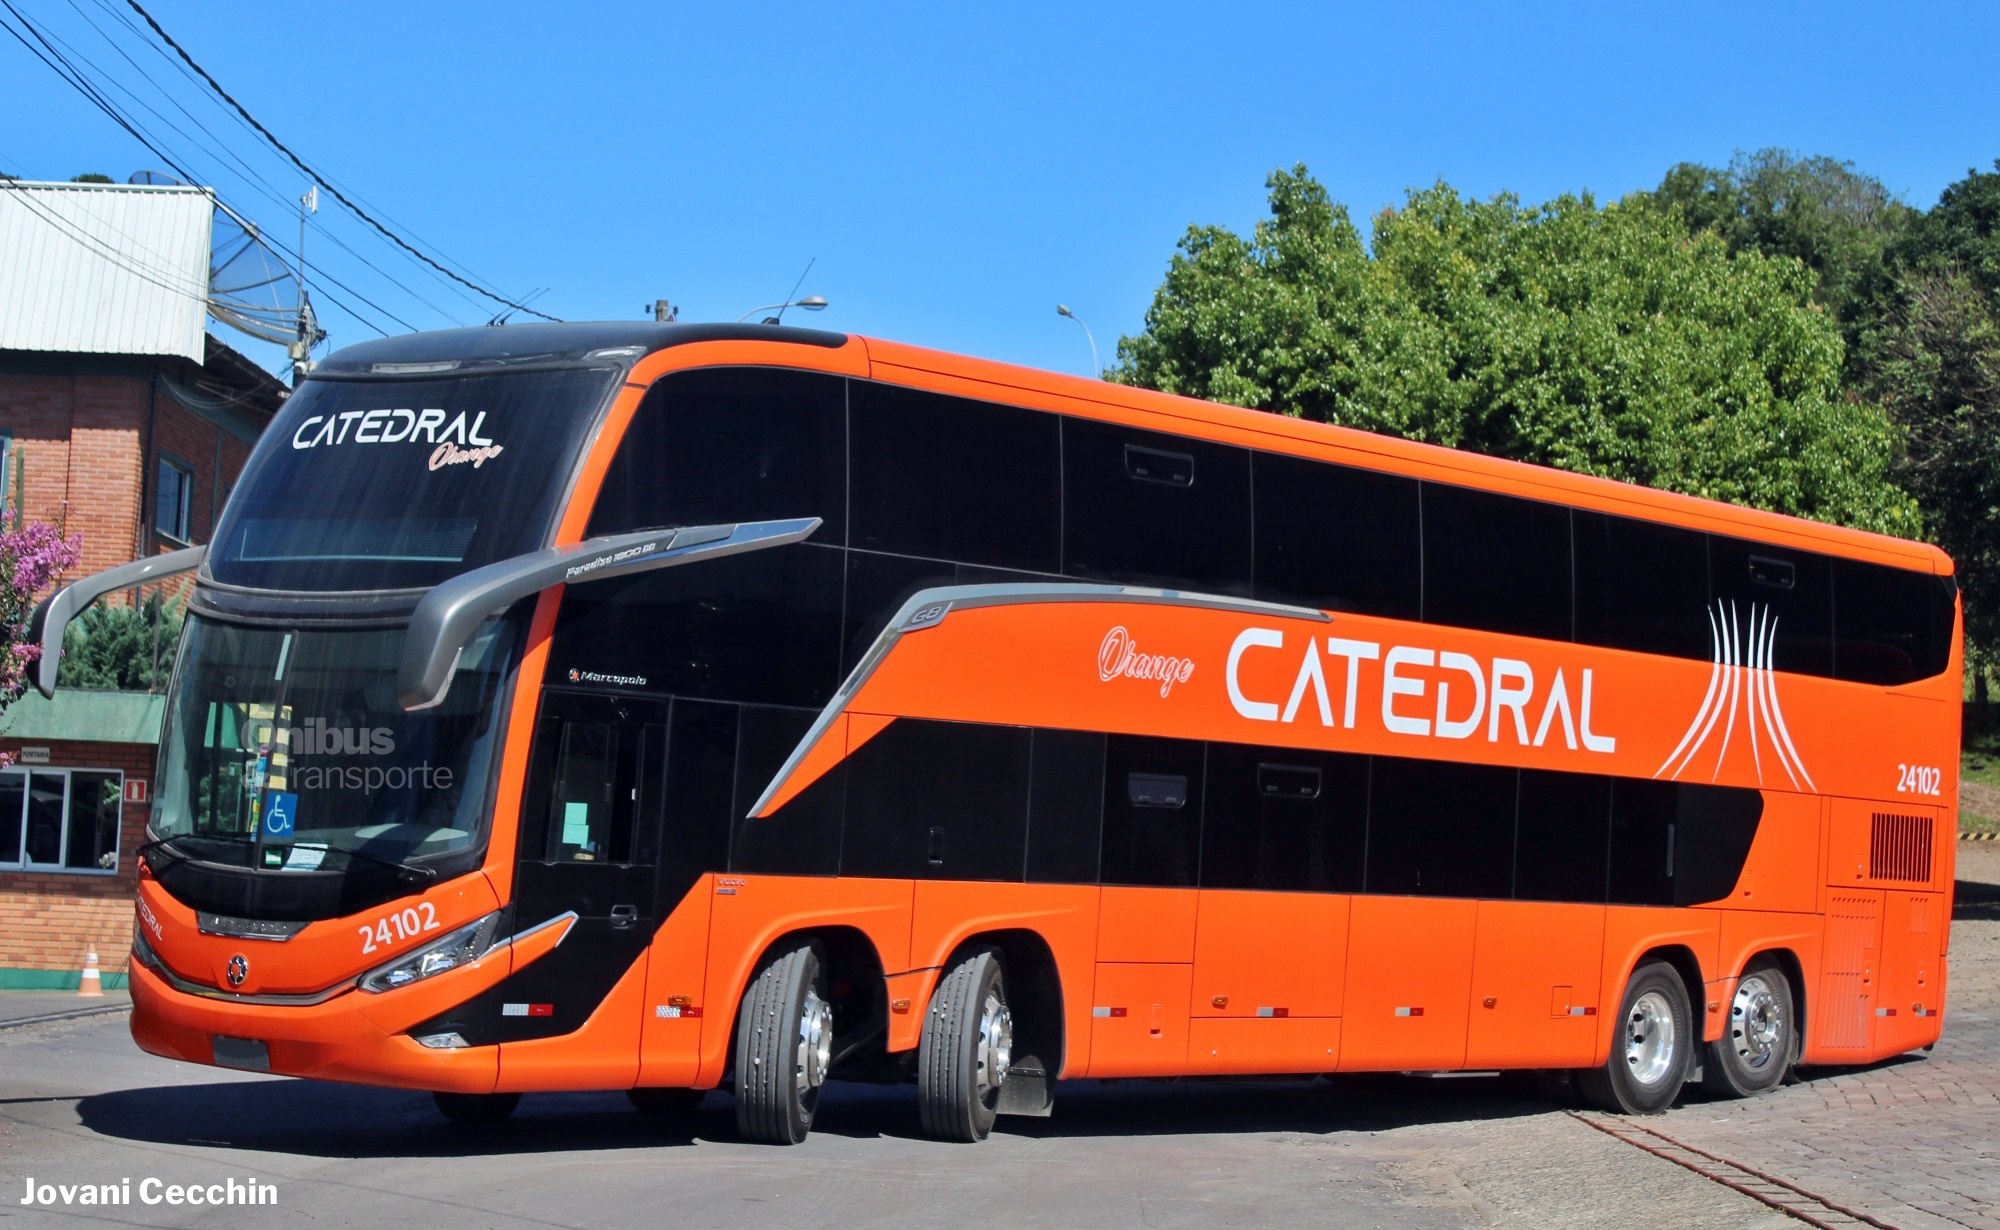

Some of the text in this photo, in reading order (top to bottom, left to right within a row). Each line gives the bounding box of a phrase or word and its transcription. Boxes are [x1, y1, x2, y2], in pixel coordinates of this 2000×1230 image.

[292, 408, 494, 450] CATEDRAL
[428, 441, 504, 471] Orange
[581, 671, 647, 685] Marcopolo
[1098, 625, 1195, 699] Orange
[1225, 627, 1616, 753] CATEDRAL
[1896, 763, 1941, 796] 24102
[358, 902, 441, 954] 24102
